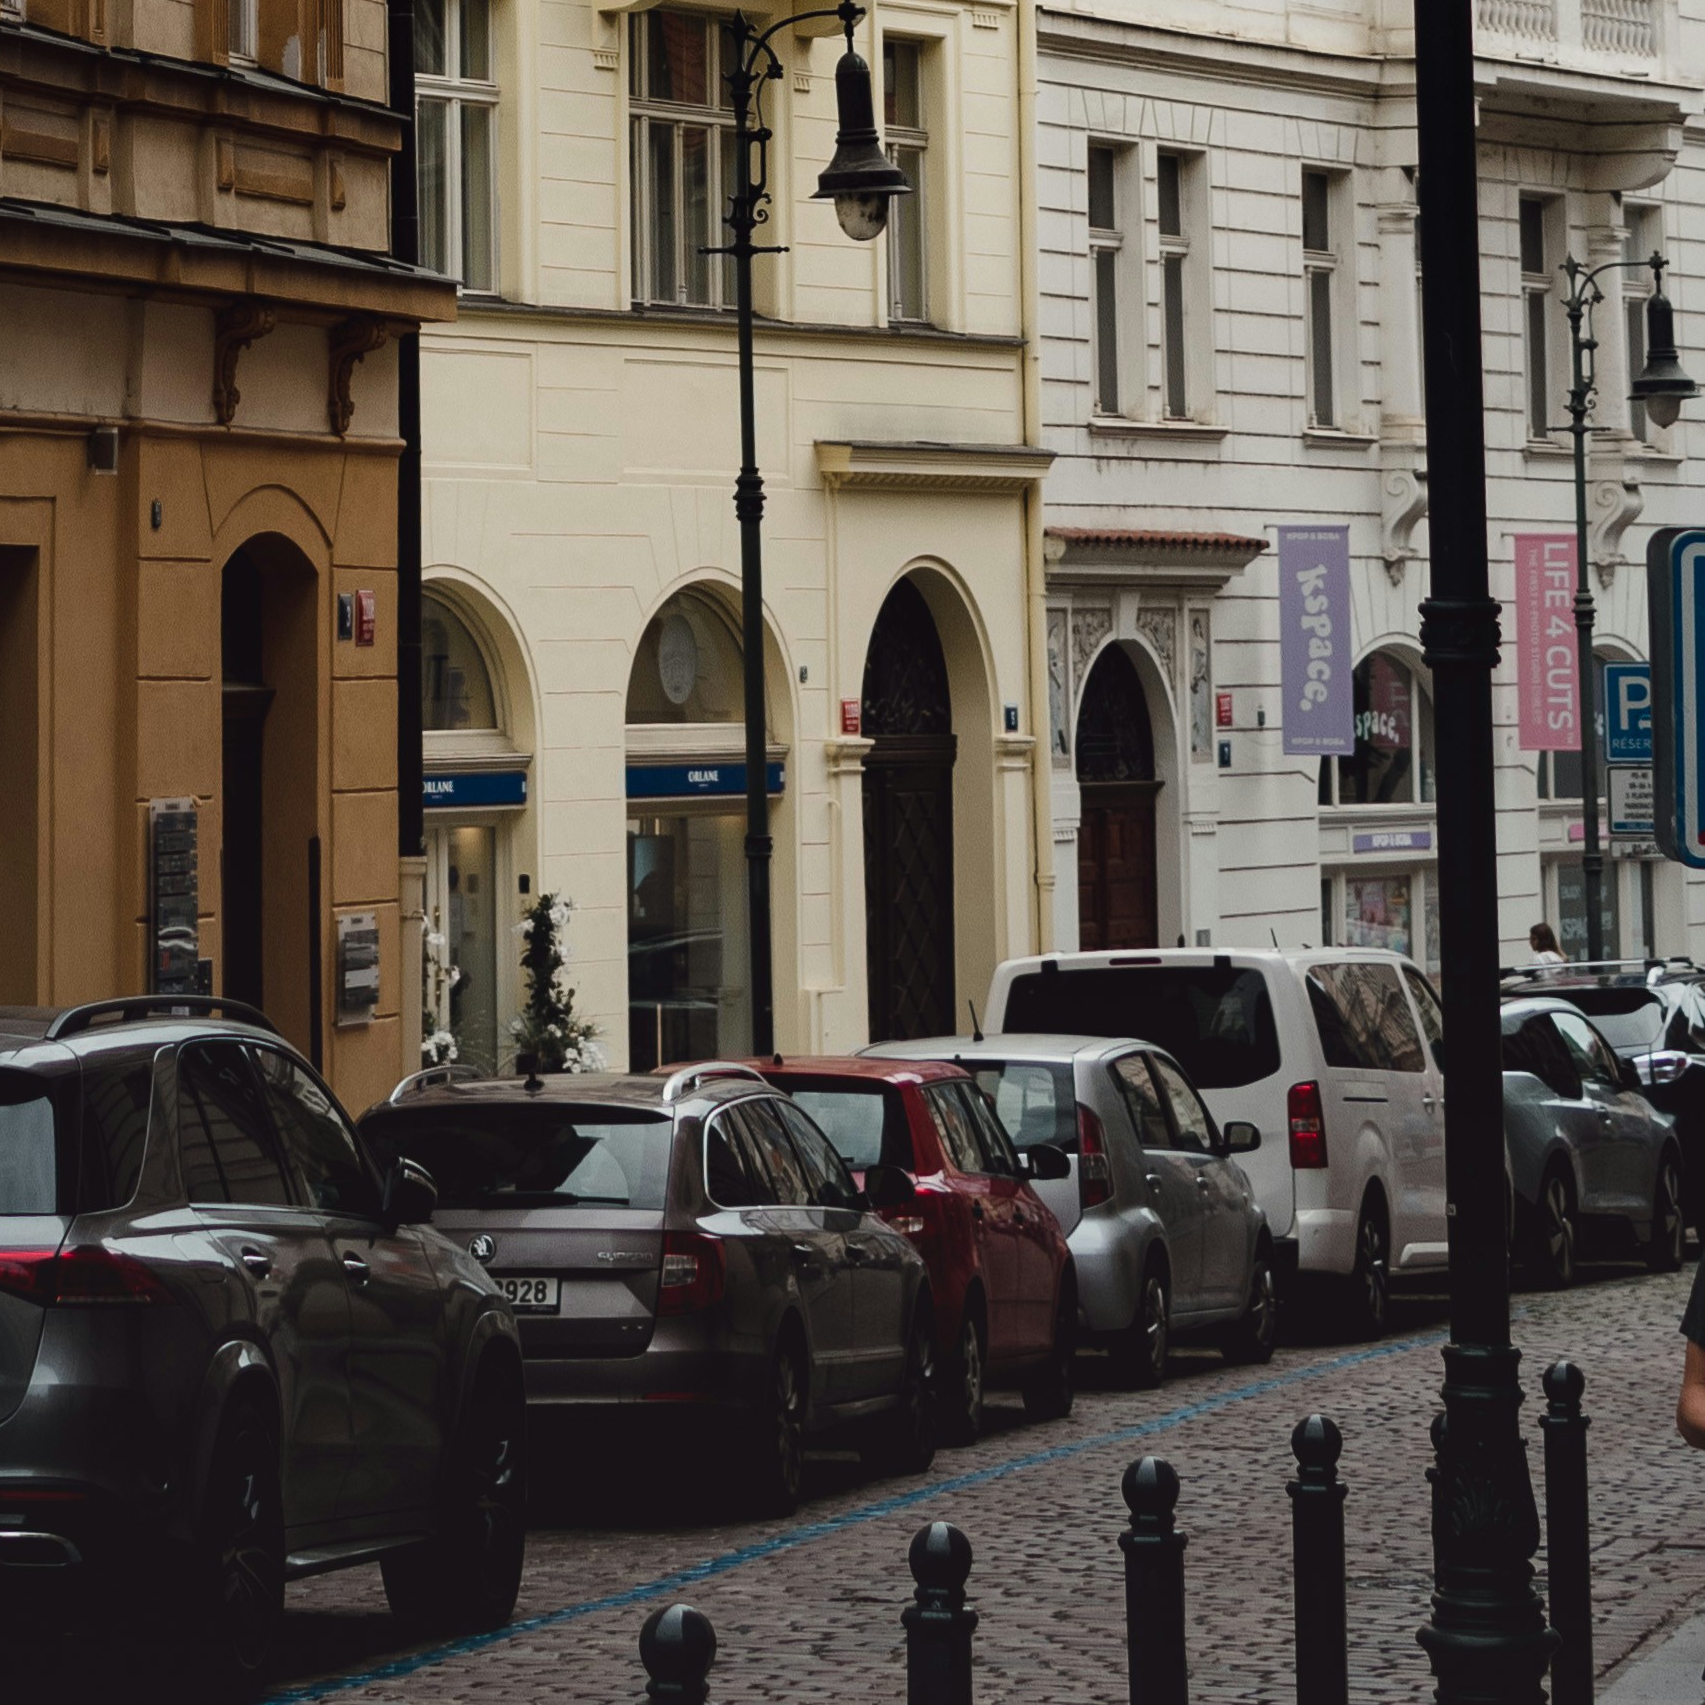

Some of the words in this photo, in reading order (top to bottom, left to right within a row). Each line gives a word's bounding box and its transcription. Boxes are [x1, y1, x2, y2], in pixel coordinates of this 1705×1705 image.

[1543, 541, 1571, 608] LIFE
[1544, 615, 1572, 639] 4
[1618, 675, 1651, 732] P
[1612, 737, 1652, 750] RÉSER
[687, 769, 720, 783] ORLANE
